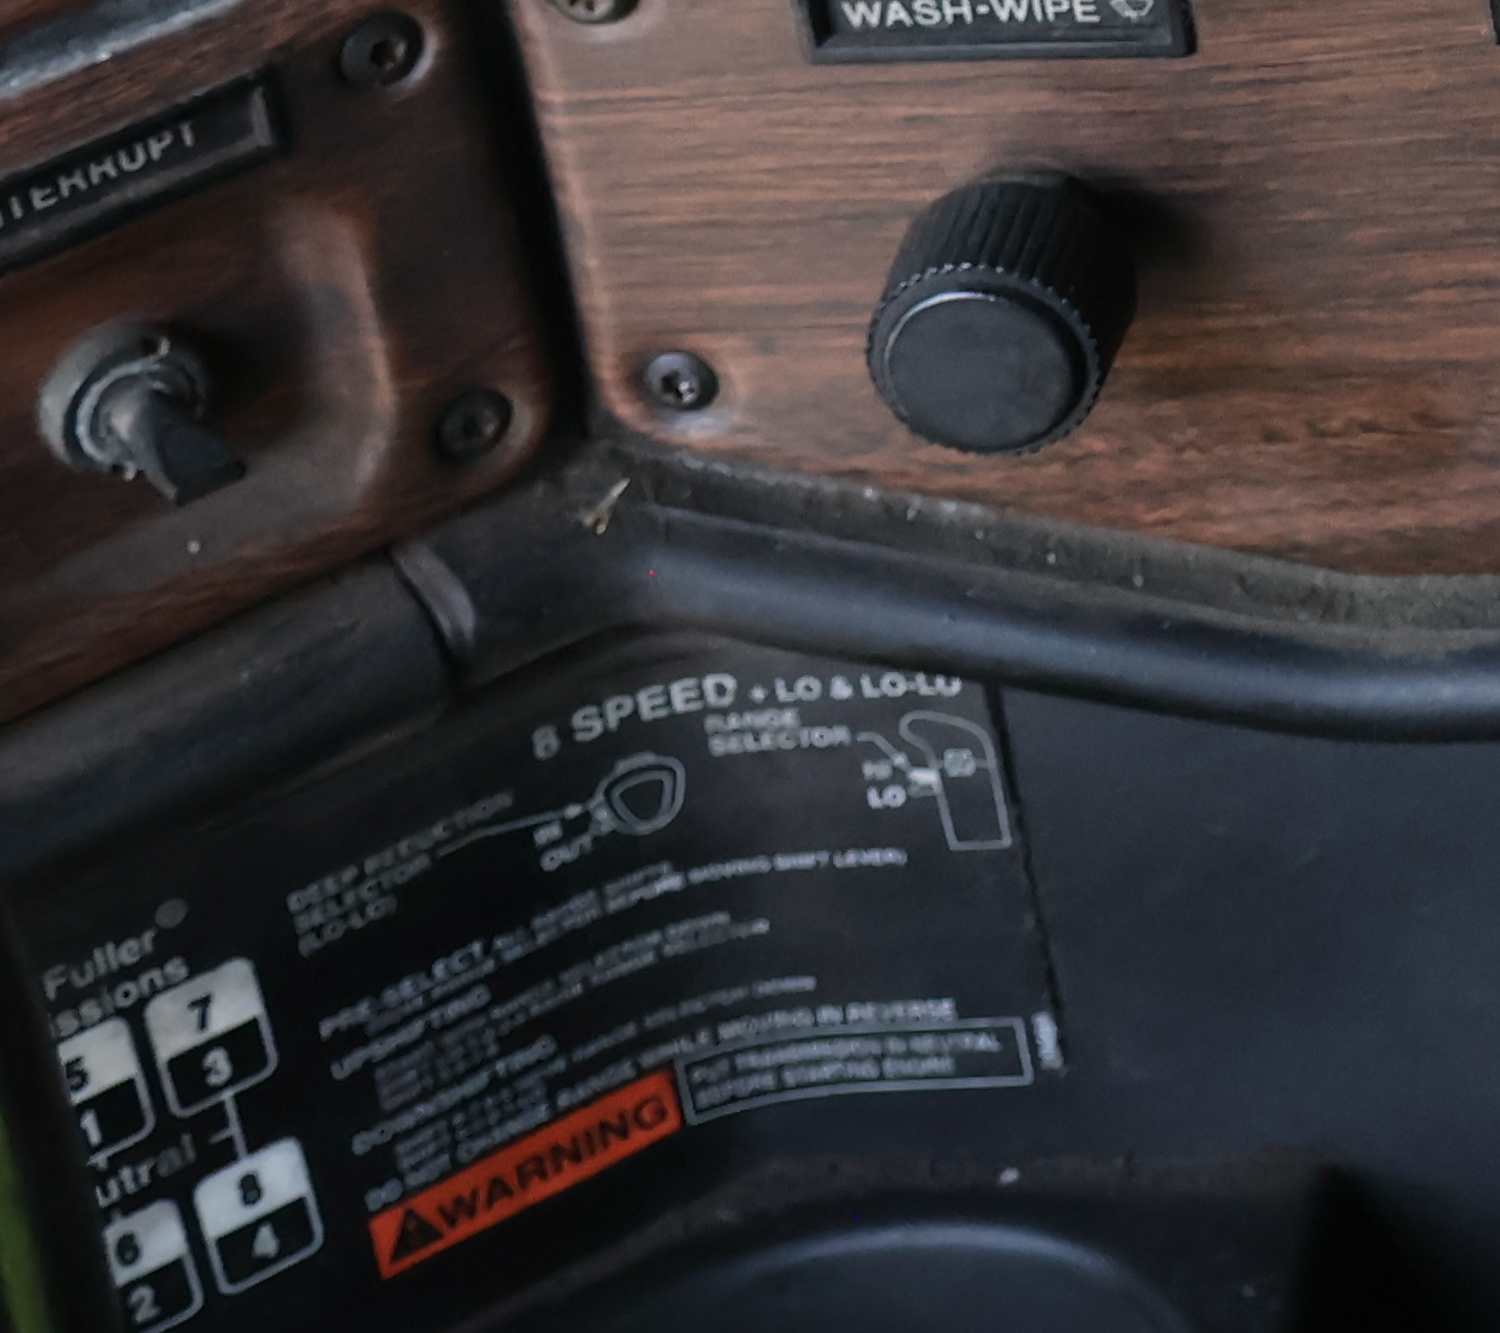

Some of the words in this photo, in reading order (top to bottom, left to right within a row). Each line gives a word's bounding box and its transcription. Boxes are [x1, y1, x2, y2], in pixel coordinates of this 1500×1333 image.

[0, 122, 195, 228] TERRUPT
[531, 724, 560, 760] 8
[571, 672, 737, 743] SPEED
[775, 676, 821, 701] LO
[866, 784, 907, 809] LO
[42, 927, 157, 1002] Fuller
[188, 994, 212, 1031] 7
[203, 1046, 234, 1087] 3
[95, 1133, 198, 1208] utral
[435, 1093, 669, 1231] WARNING
[239, 1174, 263, 1207] 8
[116, 1233, 140, 1267] 6
[251, 1221, 280, 1259] 4
[127, 1284, 161, 1324] 2
